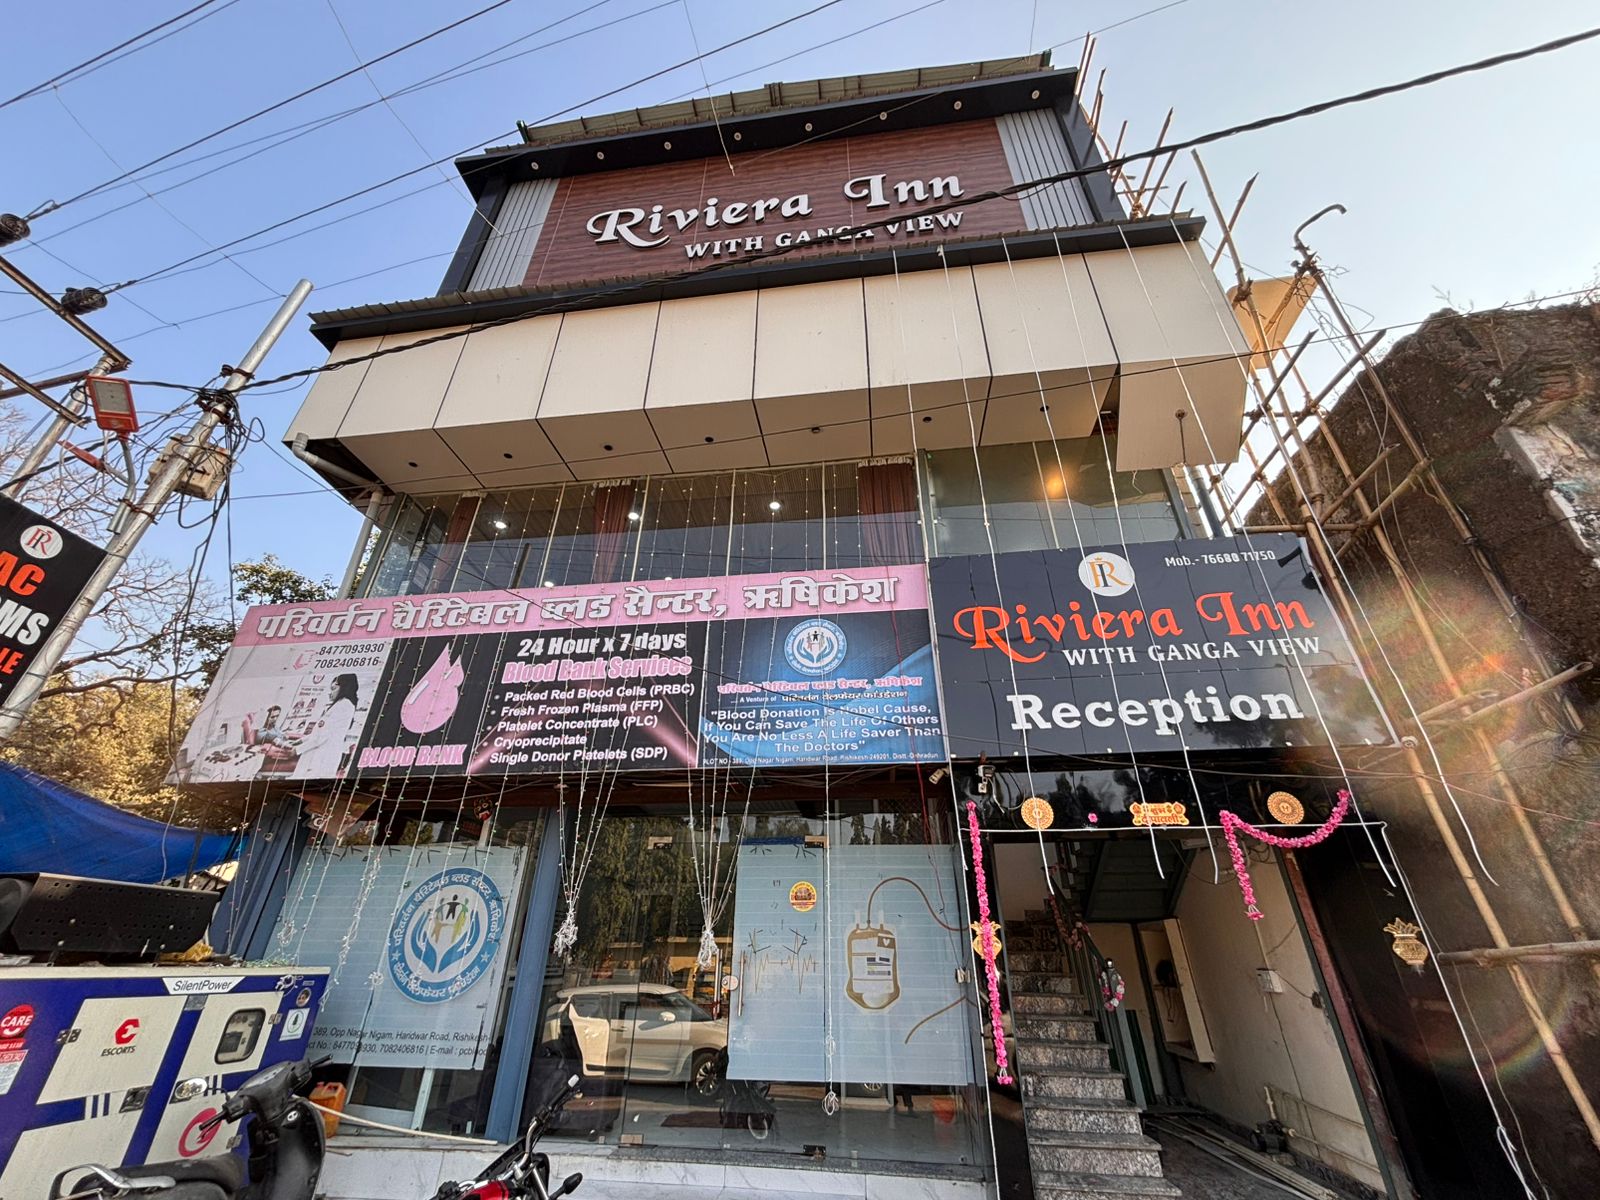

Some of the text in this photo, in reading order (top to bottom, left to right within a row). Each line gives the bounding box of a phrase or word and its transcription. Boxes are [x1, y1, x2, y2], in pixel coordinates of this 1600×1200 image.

[586, 173, 964, 249] Riviera Inn
[684, 235, 763, 259] WITH
[885, 211, 964, 235] VIEW
[256, 602, 386, 639] परिवर्तन
[391, 597, 532, 631] चैरिटेबल
[540, 594, 616, 621] ब्लड
[742, 573, 899, 609] ऋषिकेश
[953, 591, 1315, 664] Riviera Inn
[319, 643, 385, 656] 8477093930
[517, 632, 687, 657] 24 Hour x 7 days
[1062, 636, 1321, 667] WITH GANGA VIEW
[314, 656, 380, 669] 7082406816
[501, 655, 693, 684] Blood Bank Services
[504, 683, 695, 702] Packed Red Blood Cells (PRBC)
[501, 700, 663, 717] Fresh Frozen Plasma (FFP)
[711, 703, 931, 720] "Blood Donation Is Nobel Cause,
[1006, 685, 1304, 736] Reception
[497, 715, 658, 732] Platelet Concentrate (PLC)
[704, 721, 713, 731] If
[716, 721, 741, 731] You
[745, 720, 771, 730] Can
[775, 719, 808, 730] Save
[813, 719, 837, 729] The
[841, 717, 867, 727] Life
[891, 714, 939, 726] Others
[493, 734, 587, 749] Cryoprecipitate
[703, 726, 941, 743] You Are No Less A Life Saver Than
[775, 740, 865, 753] The Doctors"
[357, 744, 468, 768] BLOOD BANK
[490, 746, 667, 765] Single Donor Platelets (SDP)
[173, 979, 232, 992] SilentPower
[1, 1014, 33, 1028] CARE
[396, 1031, 428, 1040] Haridwar
[101, 1045, 137, 1057] ESCORTS
